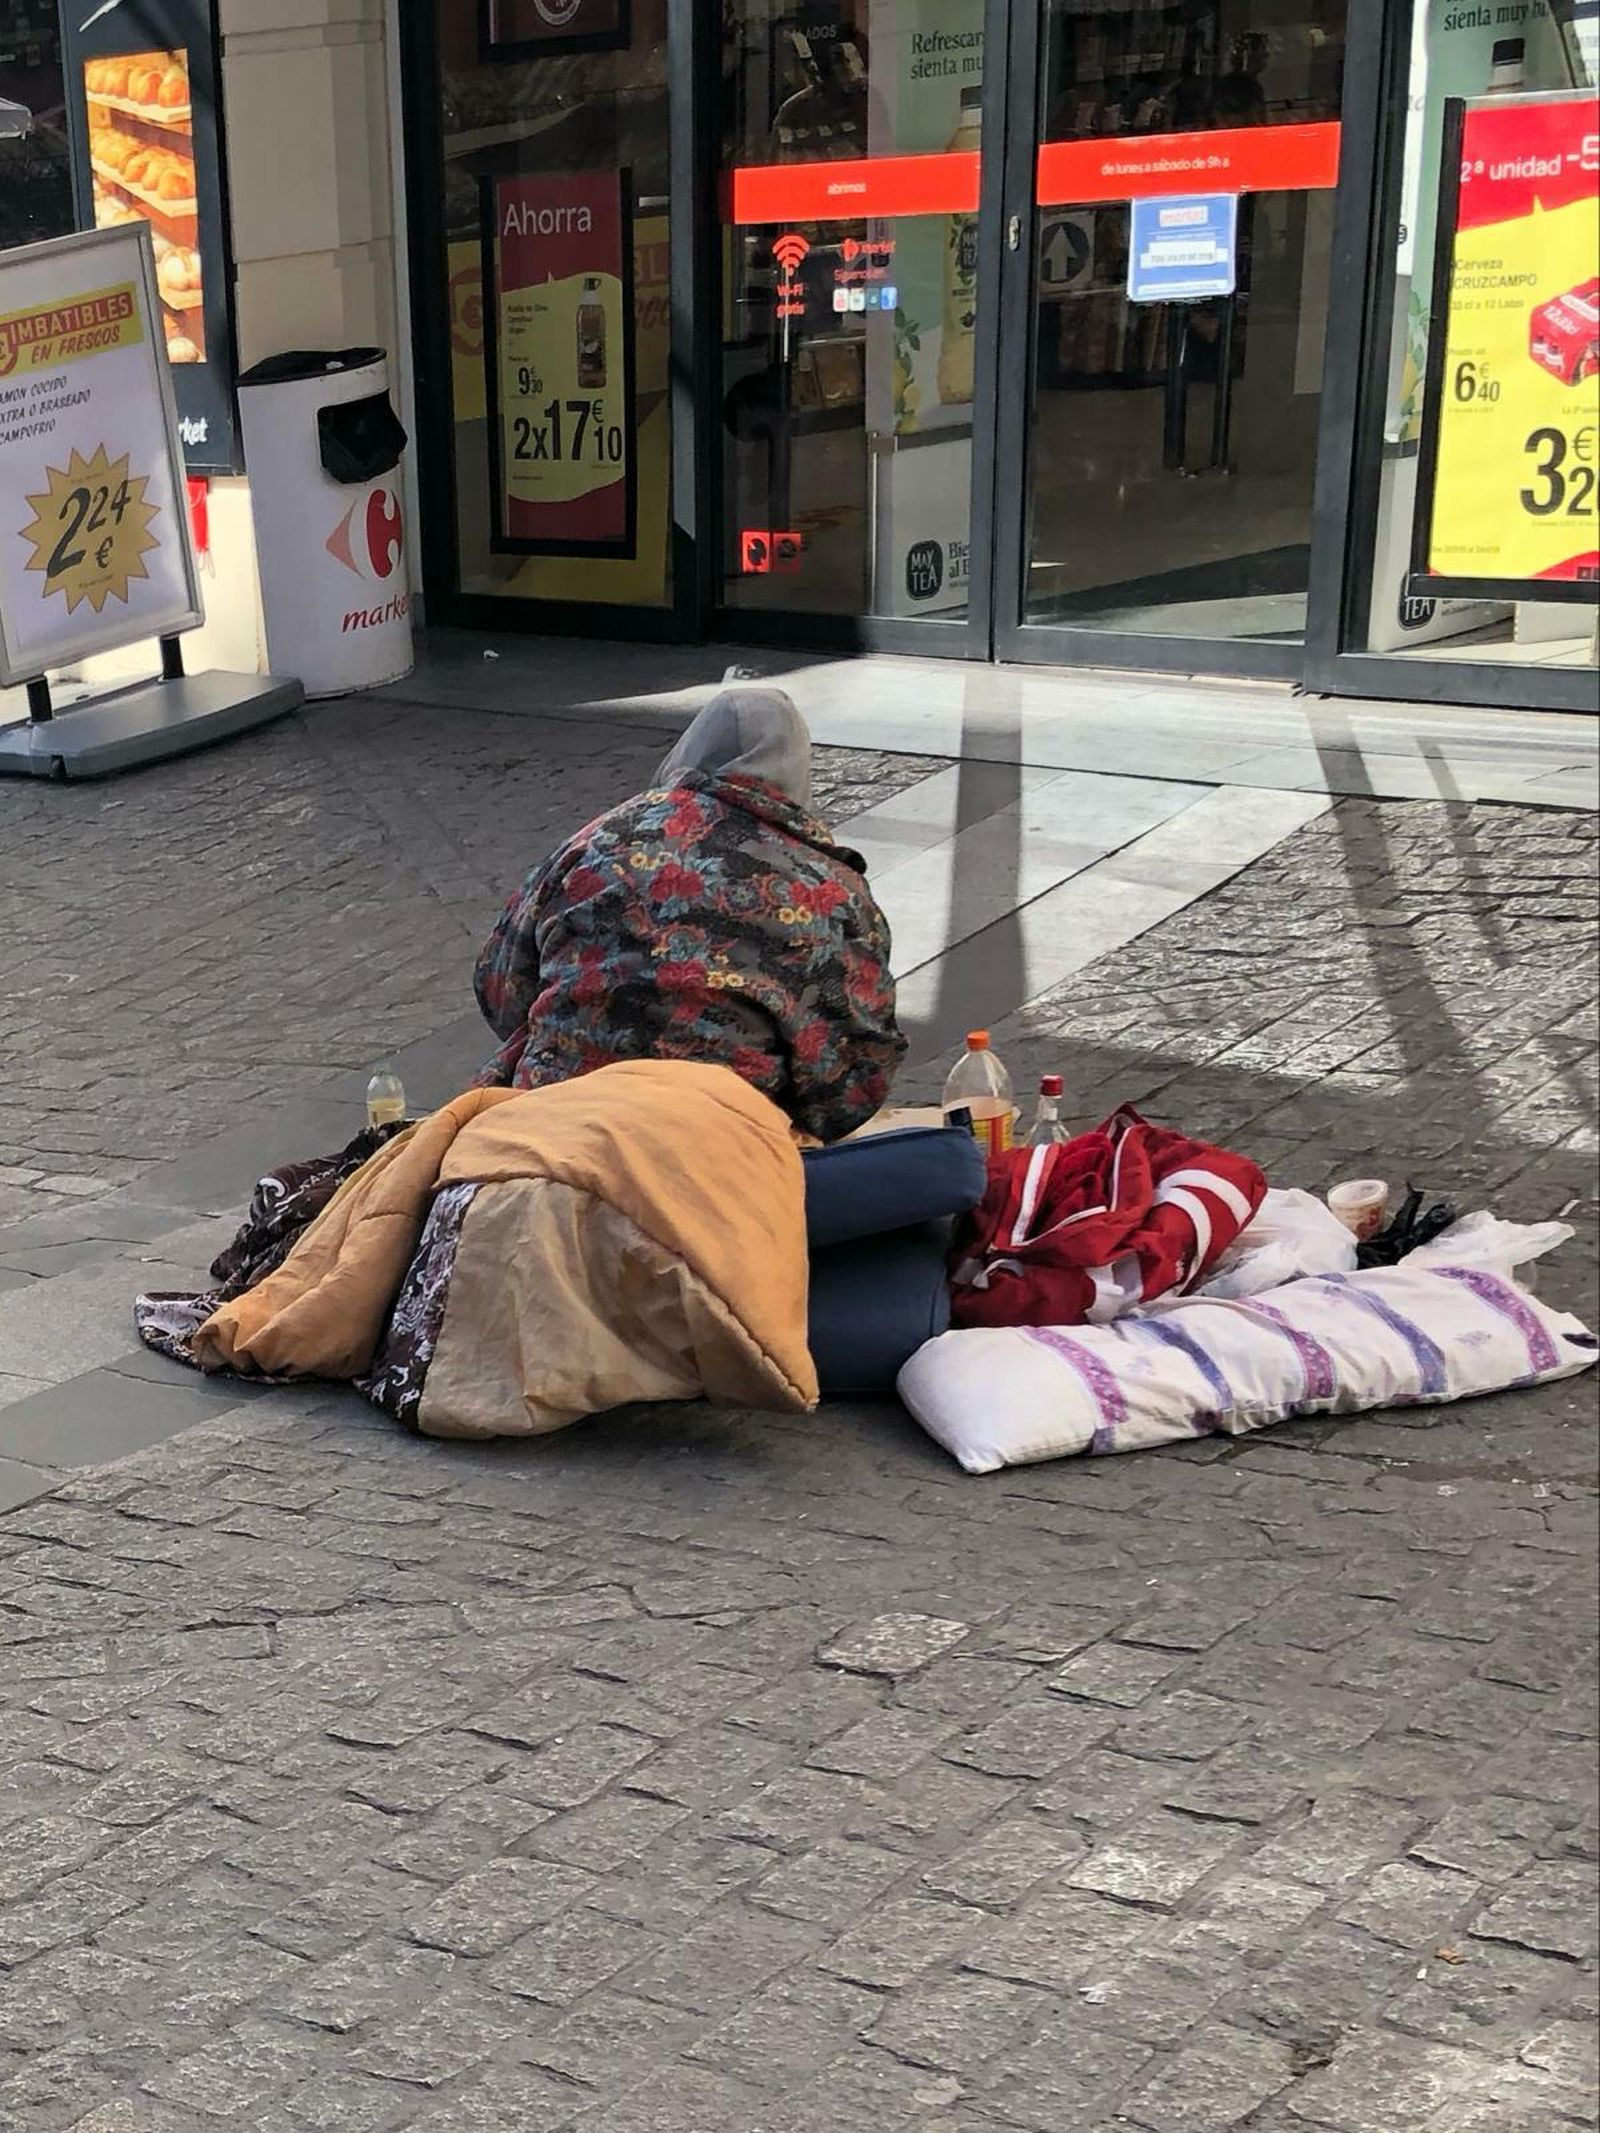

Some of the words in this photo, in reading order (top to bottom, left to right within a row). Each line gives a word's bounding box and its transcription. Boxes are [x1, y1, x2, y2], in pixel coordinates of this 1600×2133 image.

[1444, 6, 1491, 31] sienta
[1496, 4, 1528, 26] muy
[911, 57, 957, 79] sienta
[1101, 163, 1114, 176] de
[1116, 162, 1143, 175] lunes
[1192, 158, 1205, 170] de
[1489, 155, 1562, 181] unidad
[504, 201, 592, 236] Ahorra
[1455, 259, 1503, 271] Cerveza
[1454, 274, 1537, 290] CRUZCAMPO
[11, 294, 131, 344] IMBATIBLES
[32, 347, 51, 364] EN
[58, 325, 120, 357] FRESCOS
[31, 376, 67, 396] COCIDO
[29, 404, 36, 417] O
[40, 389, 91, 415] BRASEADO
[912, 549, 935, 572] MAY
[912, 565, 938, 593] TEA
[1404, 598, 1431, 621] TEA
